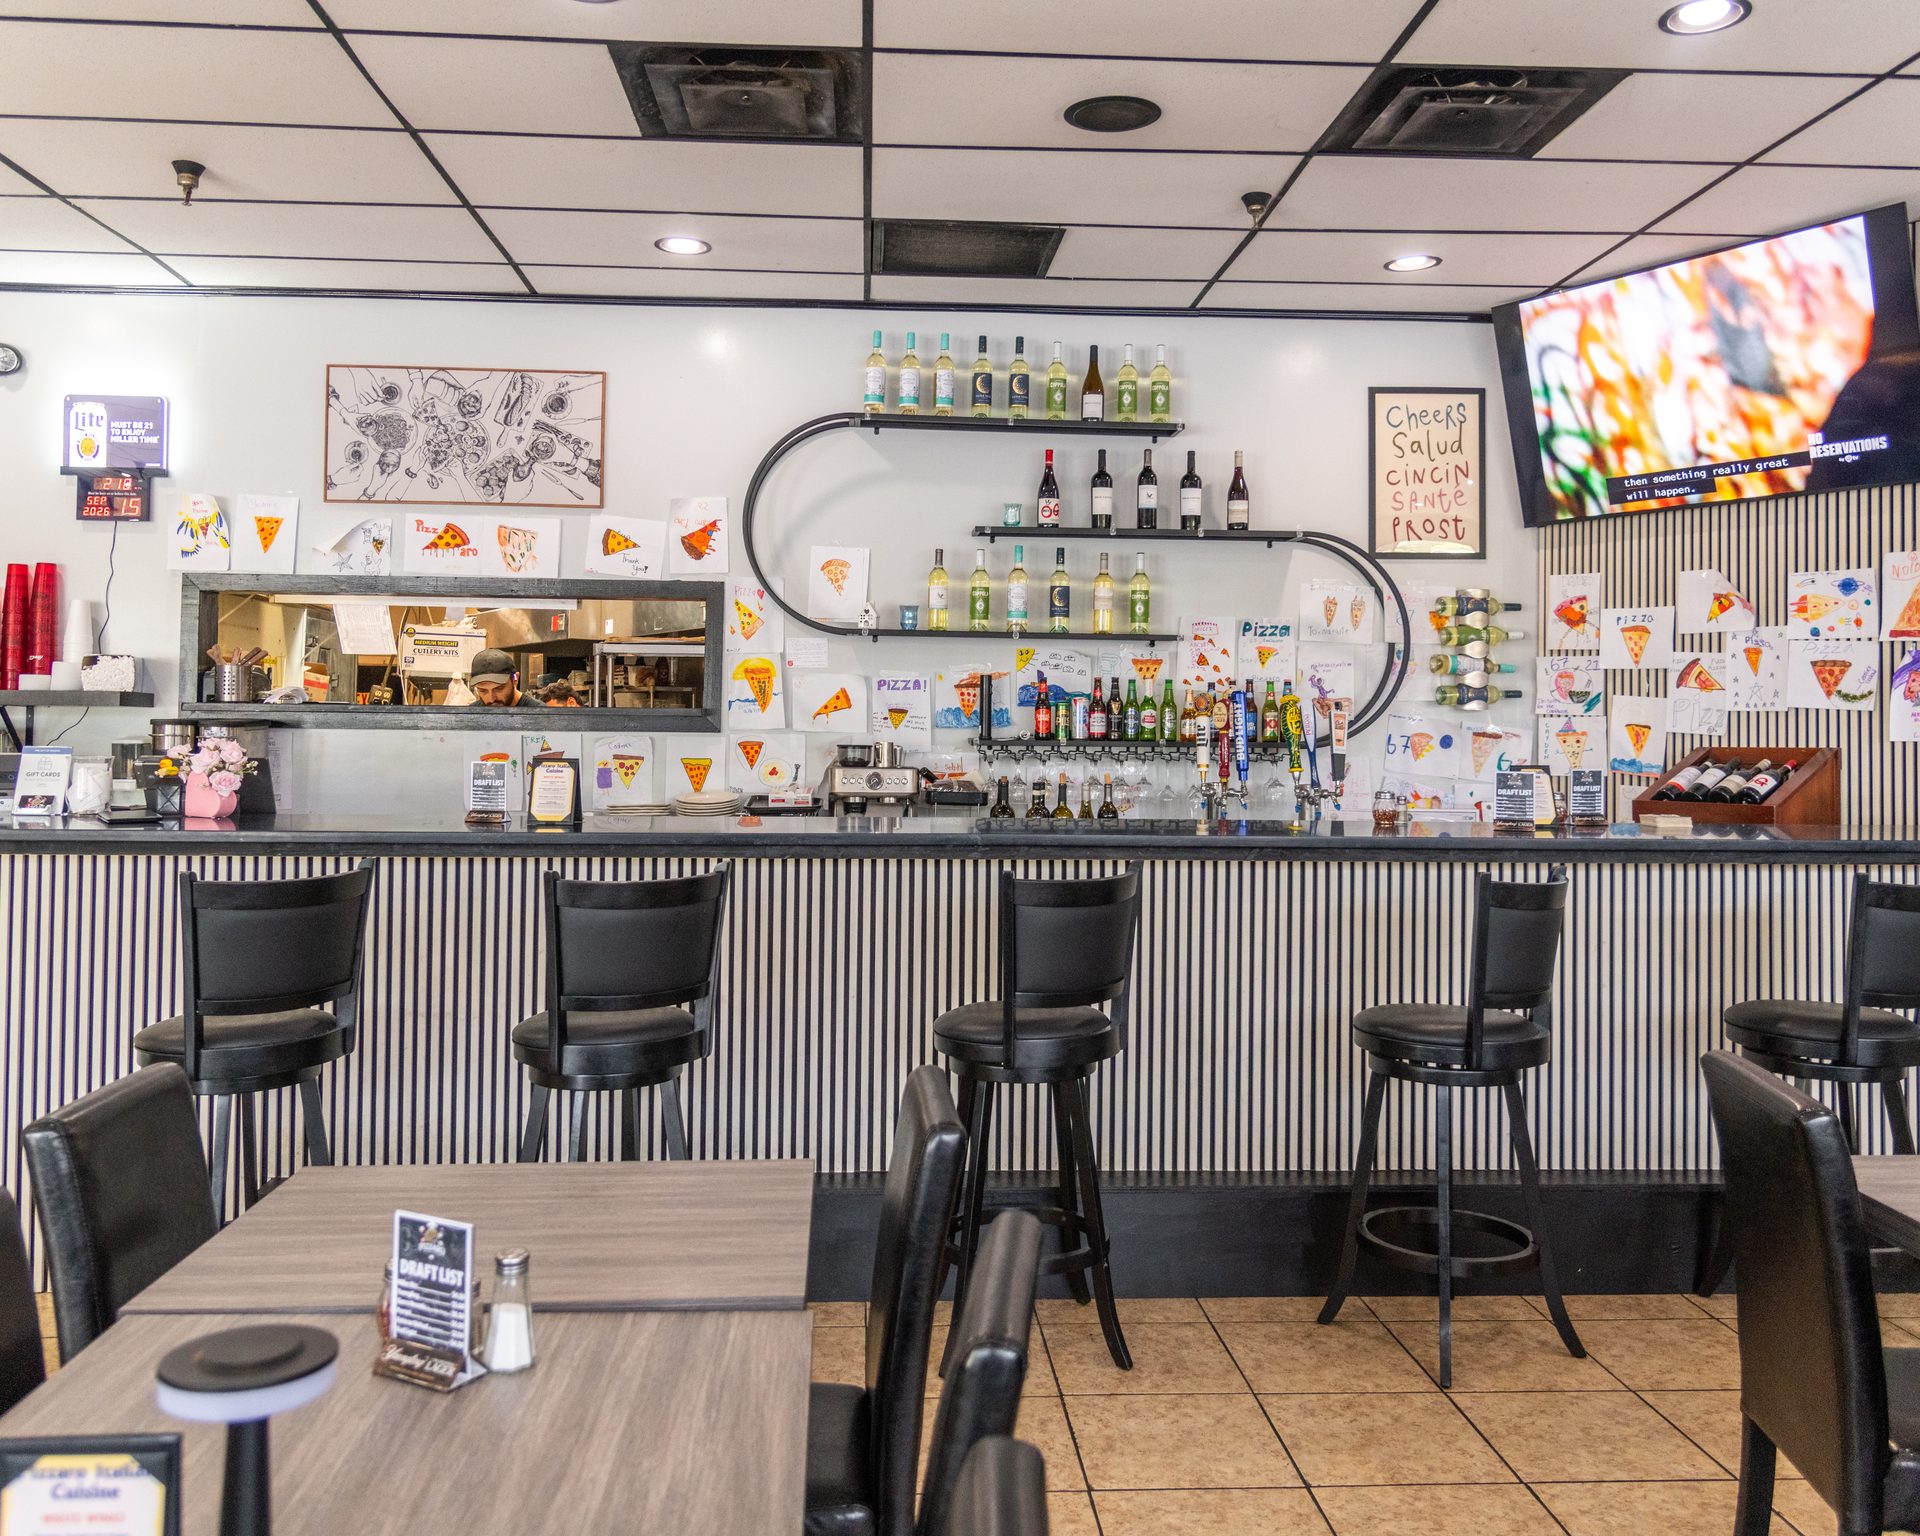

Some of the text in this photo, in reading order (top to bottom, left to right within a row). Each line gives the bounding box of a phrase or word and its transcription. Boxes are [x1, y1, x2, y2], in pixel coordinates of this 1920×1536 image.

[75, 412, 104, 431] Lite
[110, 421, 131, 429] MUST
[132, 421, 143, 429] BE
[110, 435, 138, 443] MILLER
[1392, 422, 1463, 462] Salud
[1807, 432, 1823, 446] NO
[1809, 436, 1888, 458] RESERVATIONS
[1624, 457, 1789, 488] then something really great
[87, 496, 107, 505] SEP
[1626, 487, 1696, 501] will happen.
[83, 507, 110, 516] 2026
[121, 498, 141, 516] 15
[1242, 621, 1291, 637] Pizza
[1551, 657, 1569, 671] 67
[877, 679, 926, 692] PIZZA!
[1197, 724, 1209, 747] Lite
[1234, 702, 1246, 760] BUD LIGHT
[1386, 734, 1411, 755] 67
[400, 1259, 465, 1287] DRAFT LIST
